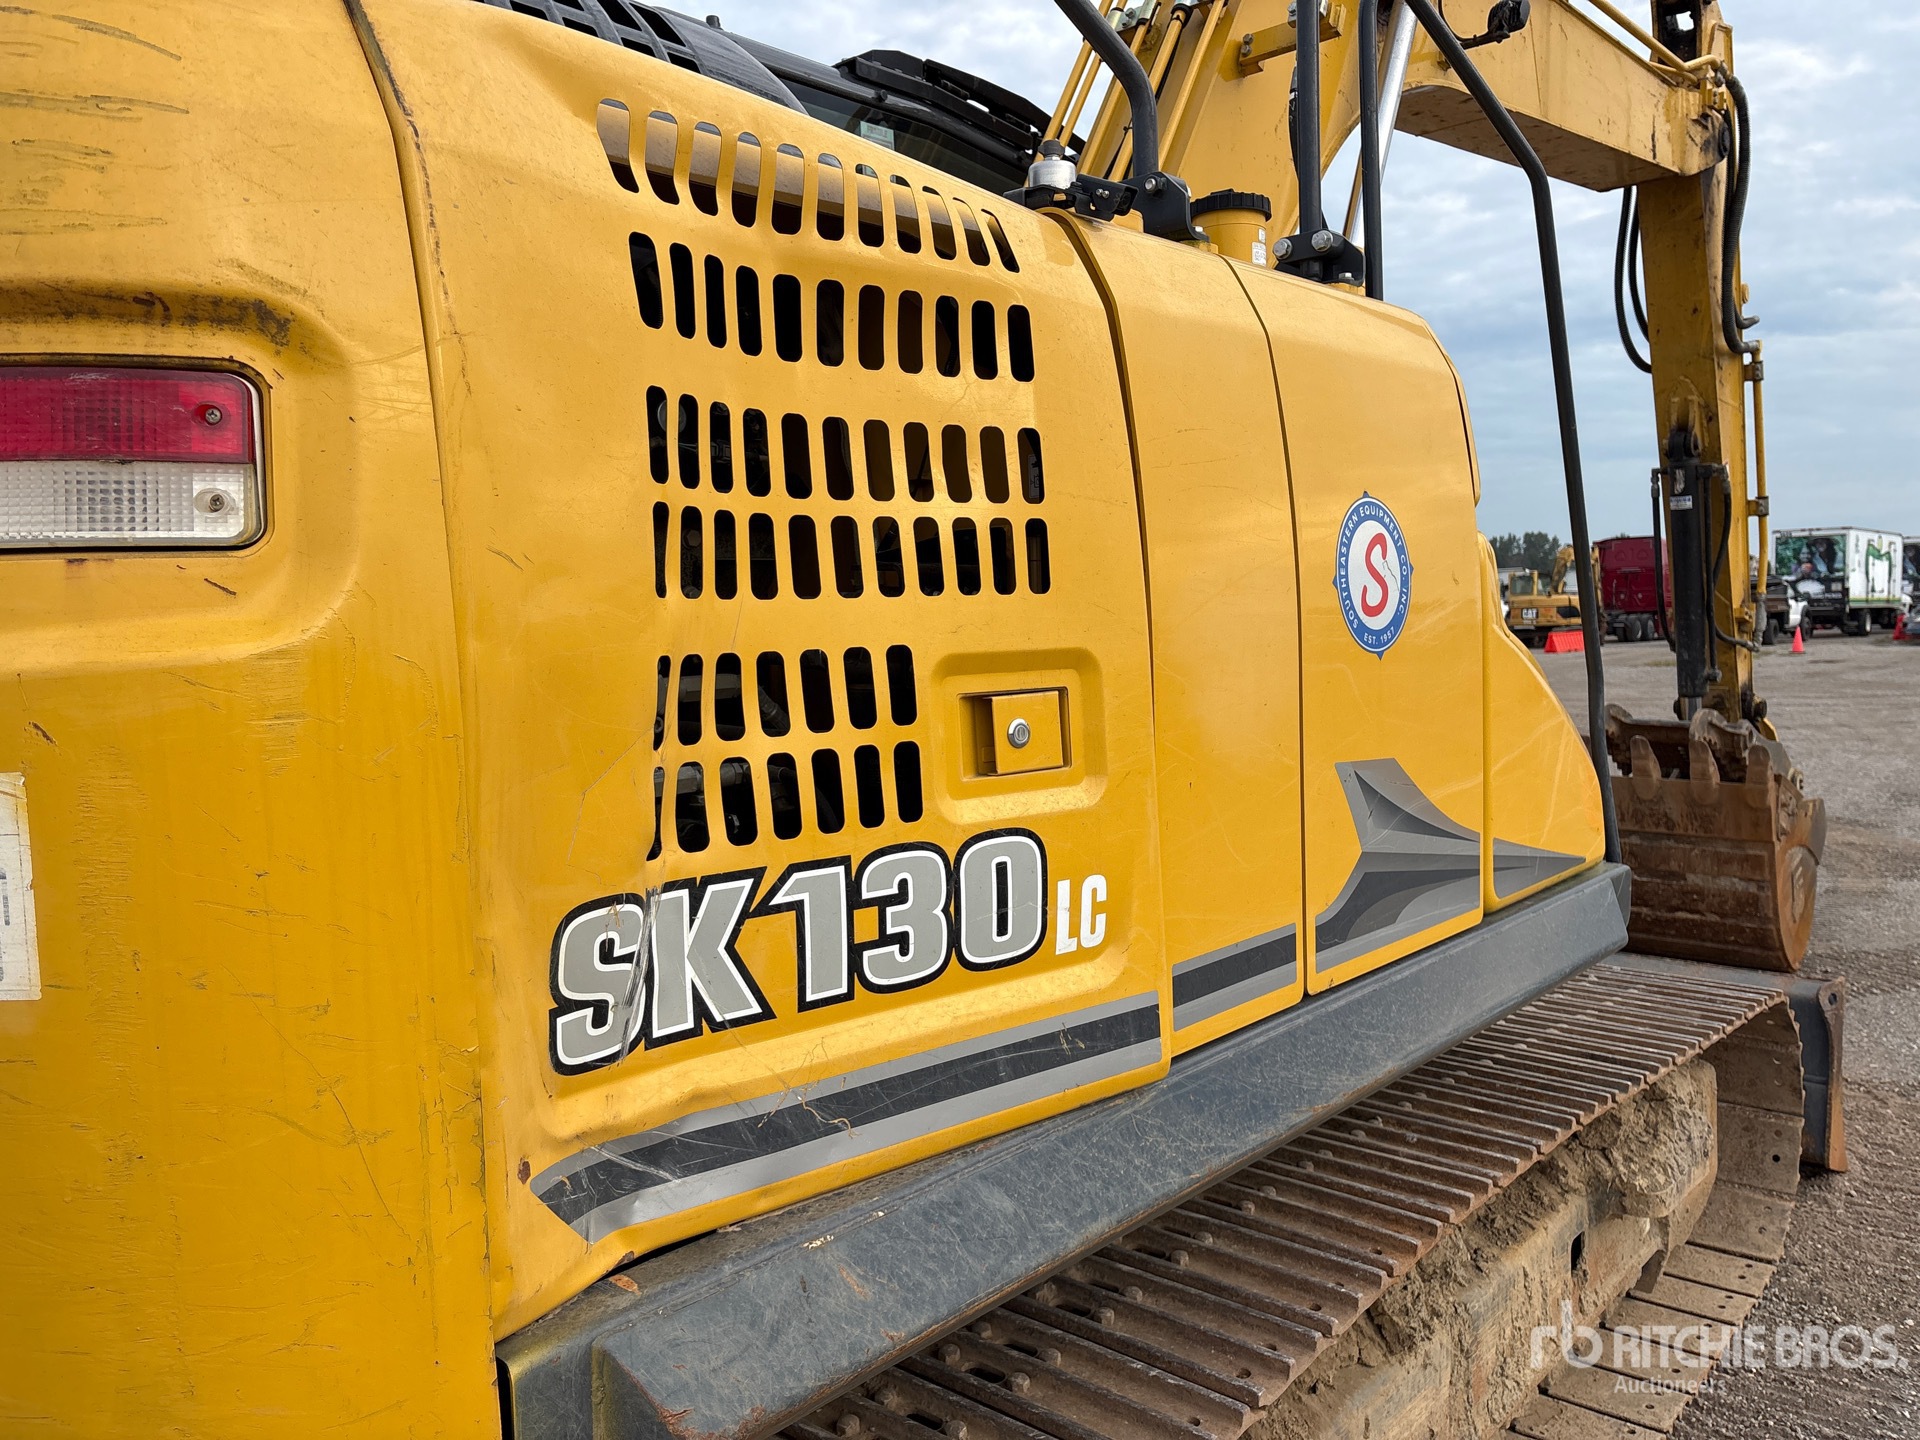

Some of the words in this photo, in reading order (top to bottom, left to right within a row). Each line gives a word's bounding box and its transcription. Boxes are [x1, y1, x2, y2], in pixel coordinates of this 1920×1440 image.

[1359, 505, 1402, 547] EQUIPMENT
[1340, 513, 1358, 628] SOUTHEASTERN
[1361, 532, 1389, 617] S
[1400, 555, 1408, 580] CO.
[1397, 588, 1408, 615] INC.
[1363, 632, 1378, 645] EST.
[1380, 626, 1395, 643] 1957
[549, 828, 1047, 1075] SK130
[1055, 874, 1107, 955] LC
